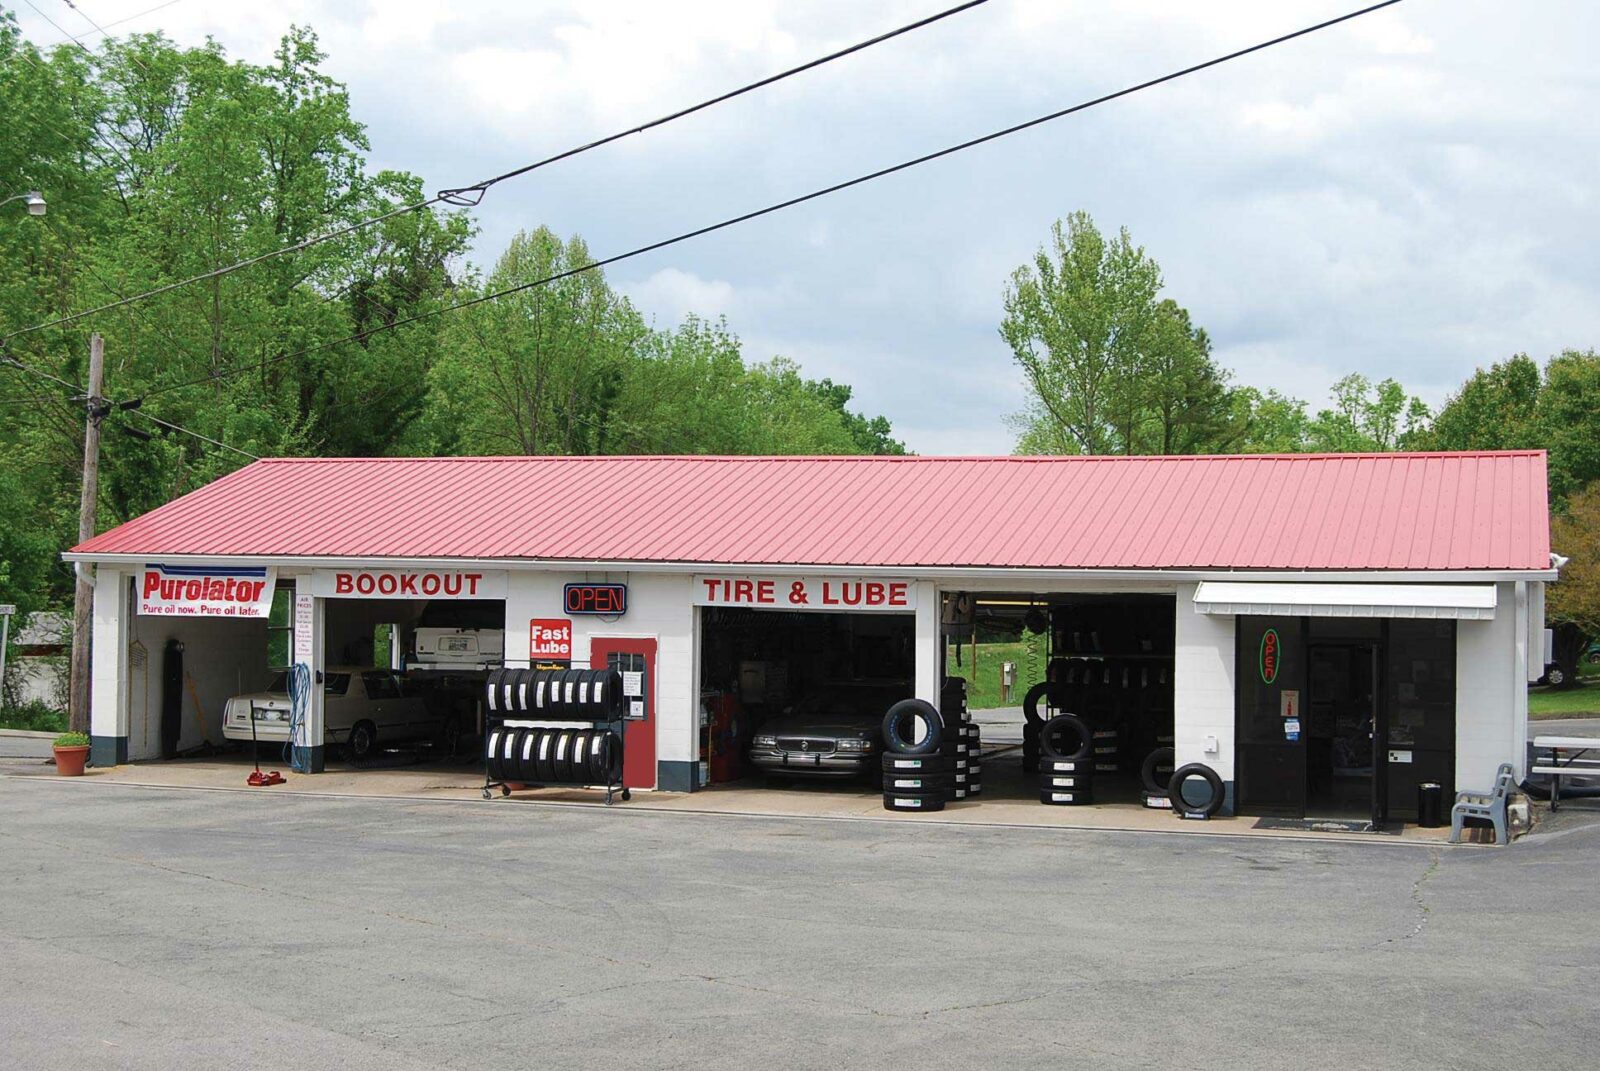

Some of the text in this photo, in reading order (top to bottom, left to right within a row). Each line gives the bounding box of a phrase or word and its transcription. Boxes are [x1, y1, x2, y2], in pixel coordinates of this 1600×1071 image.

[143, 571, 266, 602] Purolator
[335, 573, 482, 595] BOOKOUT
[703, 579, 908, 606] TIRE & LUBE
[143, 604, 163, 614] Pure
[164, 604, 175, 614] oil
[178, 606, 197, 614] now.
[200, 605, 221, 615] Pure
[224, 605, 236, 615] oil
[567, 587, 623, 611] OPEN
[532, 625, 569, 640] Fast
[531, 640, 569, 653] Lube
[1265, 633, 1275, 678] OPEN
